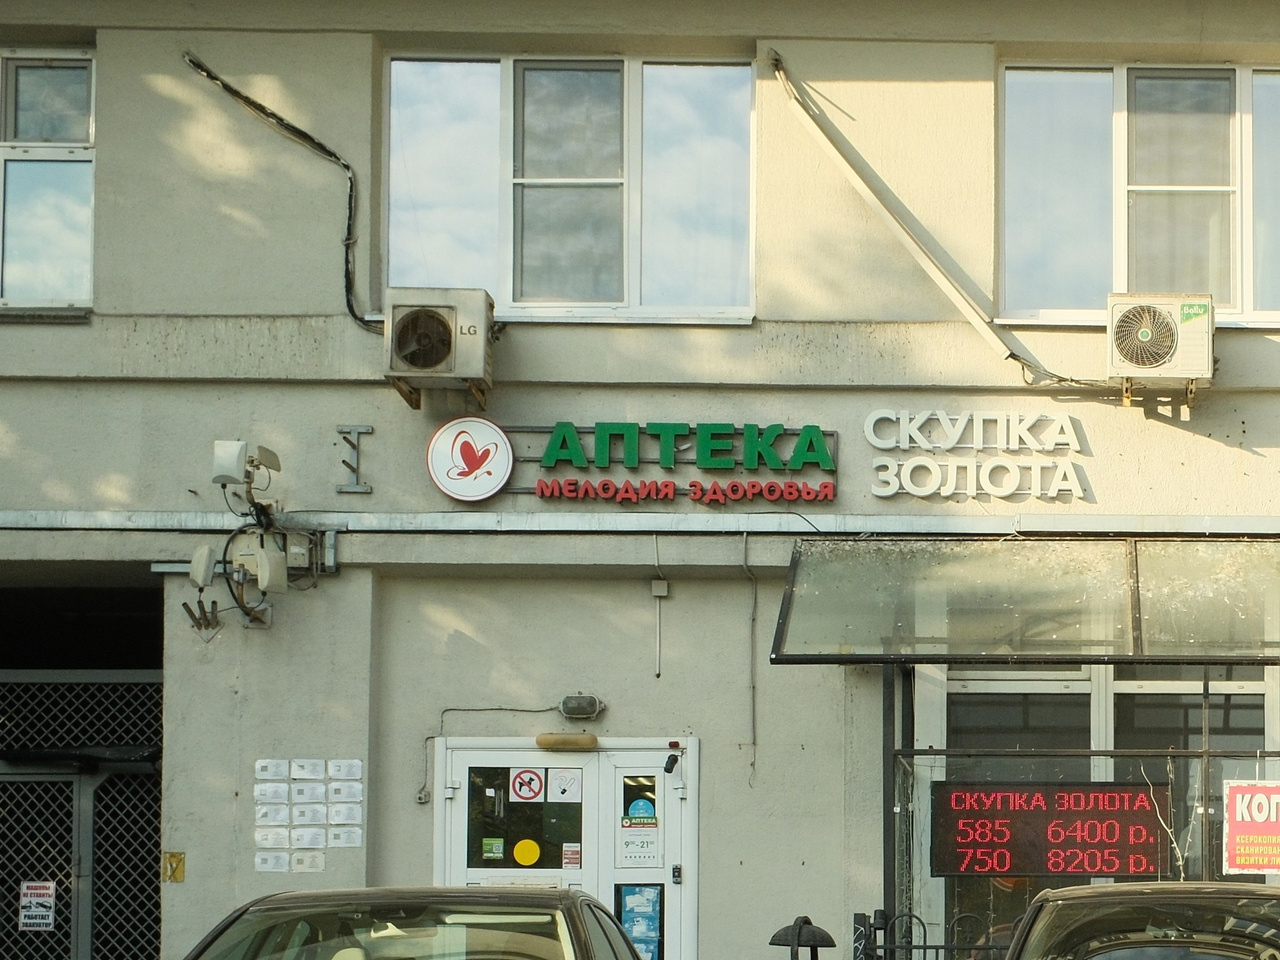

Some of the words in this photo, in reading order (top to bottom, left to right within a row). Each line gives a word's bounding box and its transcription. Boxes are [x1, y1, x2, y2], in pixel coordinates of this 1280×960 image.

[460, 325, 477, 335] LG
[863, 408, 1083, 451] СКУПКА
[539, 421, 837, 471] АПТЕКА
[870, 456, 1084, 500] ЗОЛОТА
[535, 478, 676, 503] МЕЛОДИЯ
[688, 478, 835, 505] ЗДОРОВЬЯ
[951, 792, 1047, 811] СКУПКА
[1055, 792, 1151, 811] ЗОЛОТА
[956, 819, 1011, 843] 585
[1047, 819, 1120, 843] 6400
[1129, 825, 1155, 845] р.
[956, 848, 1011, 872] 750
[1047, 848, 1120, 872] 8205
[1129, 854, 1155, 874] р.
[1236, 856, 1268, 865] ВИЗИТКИ
